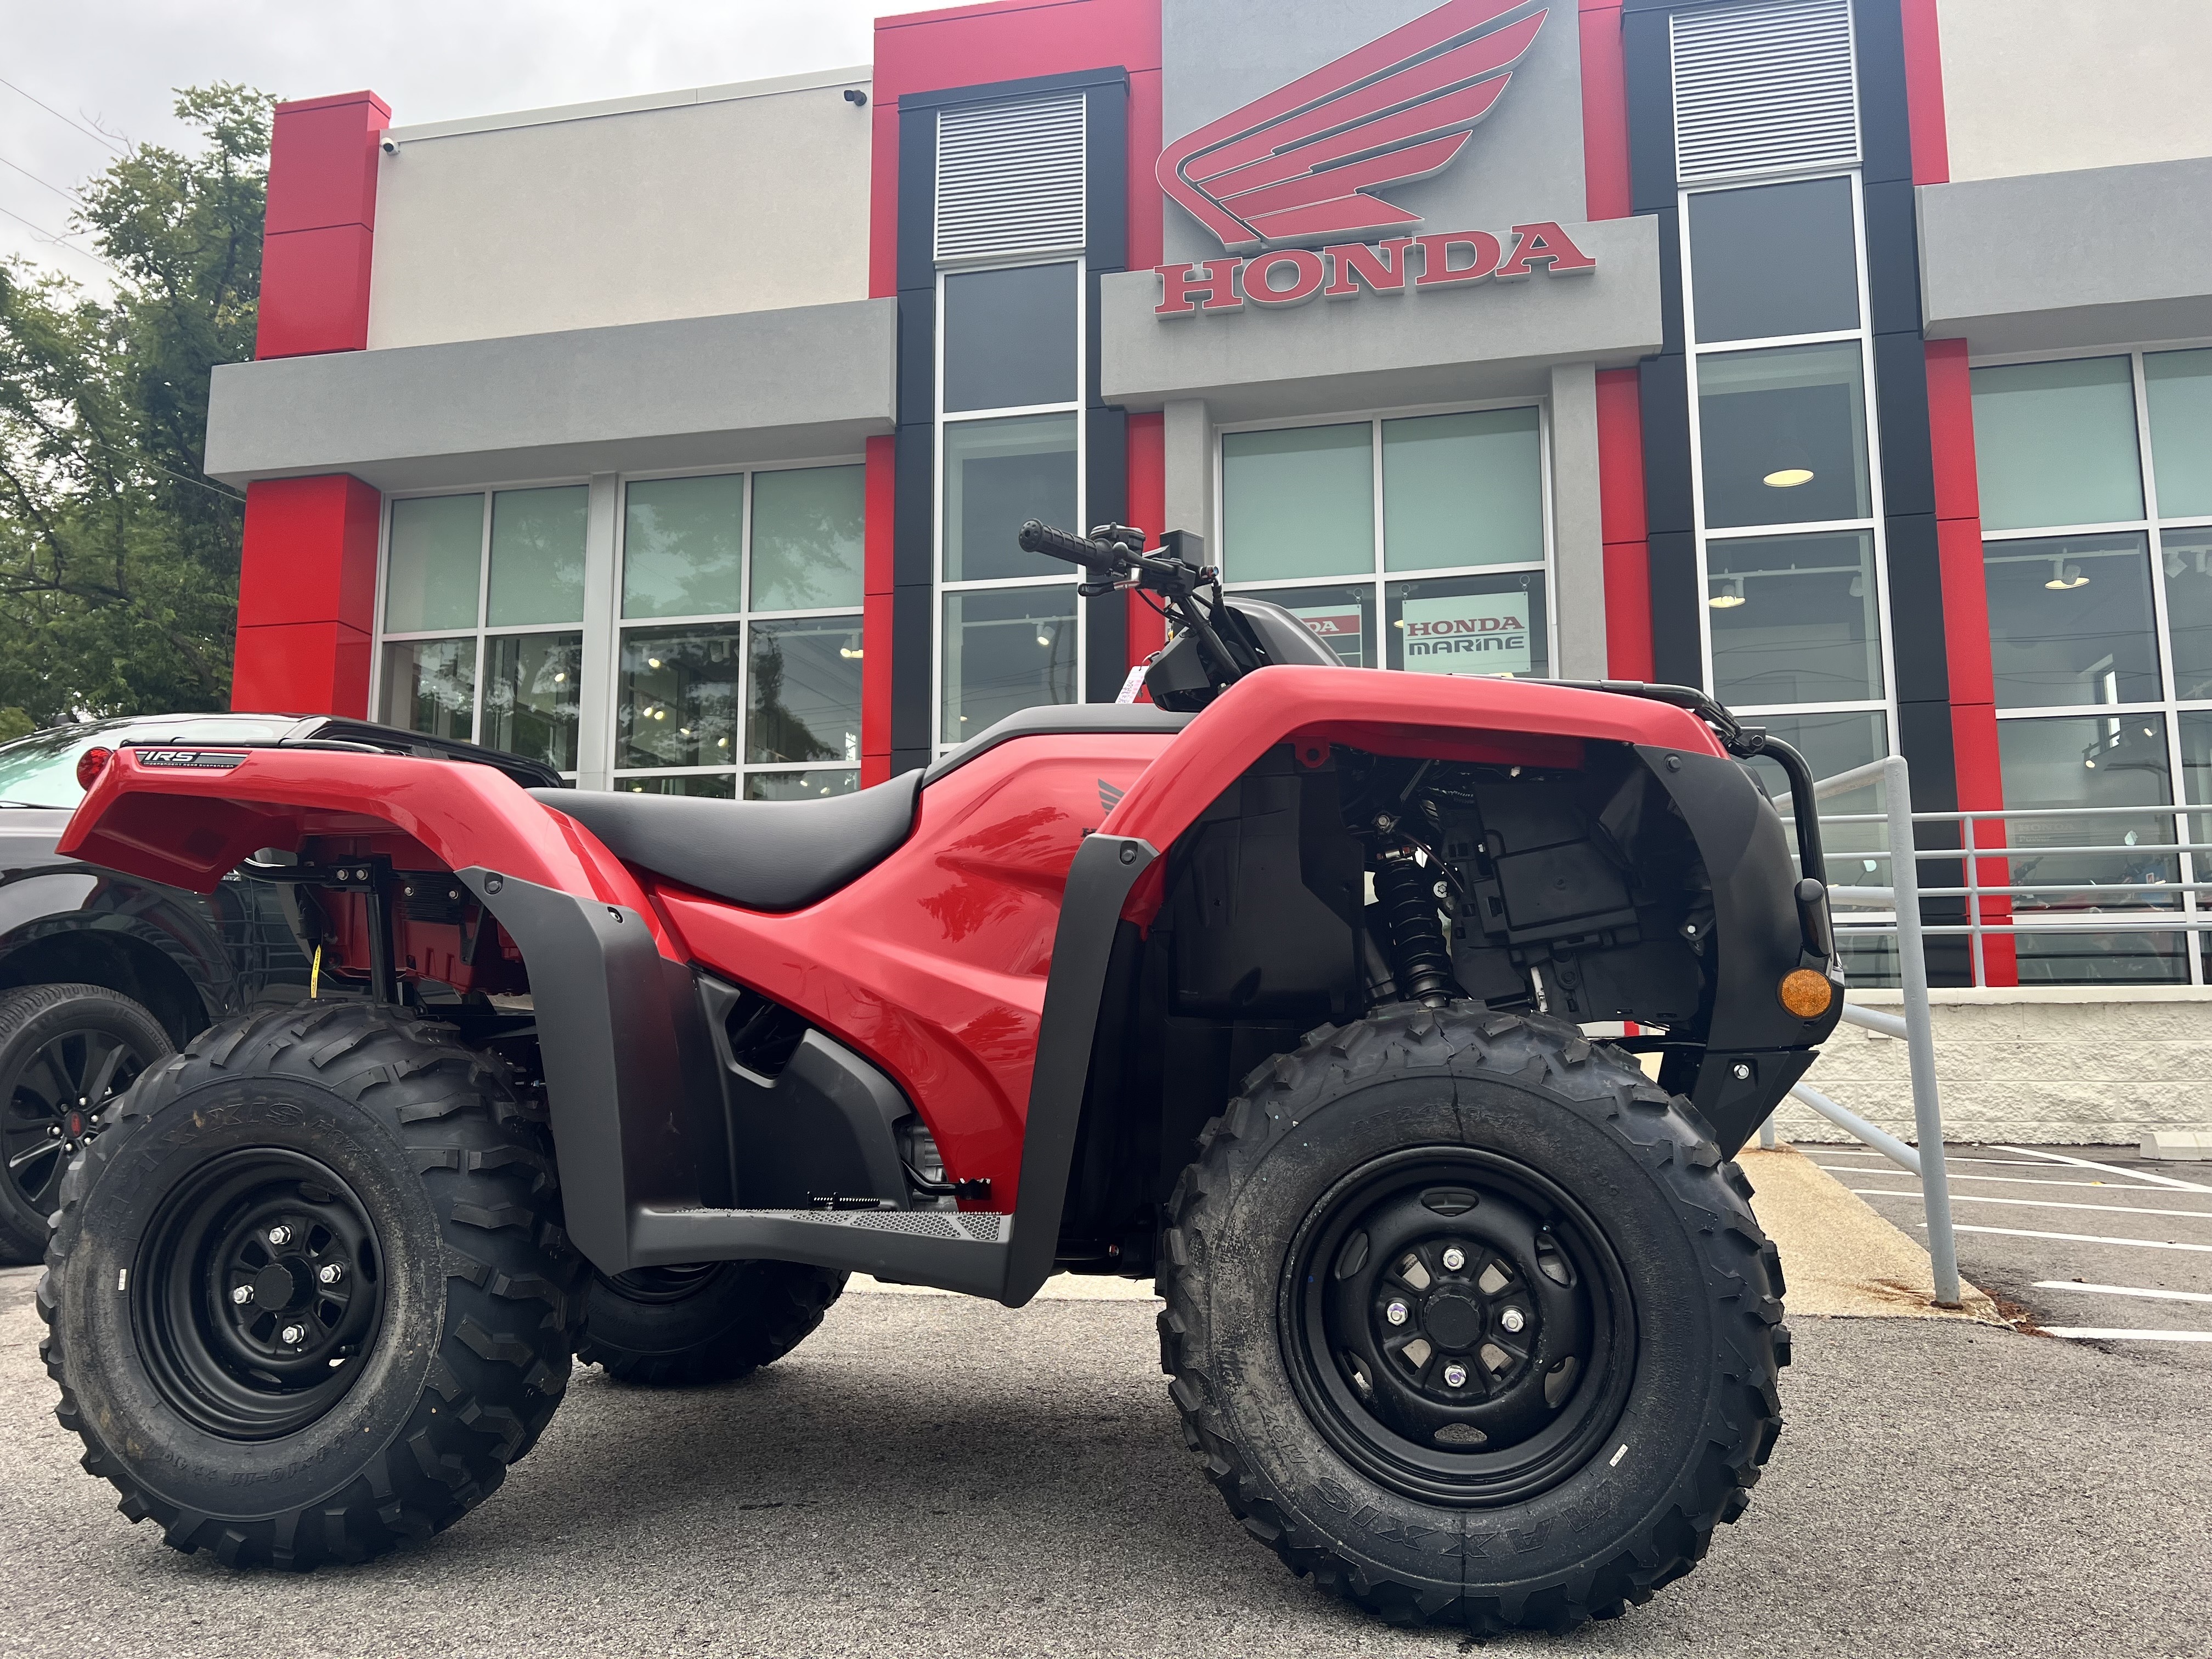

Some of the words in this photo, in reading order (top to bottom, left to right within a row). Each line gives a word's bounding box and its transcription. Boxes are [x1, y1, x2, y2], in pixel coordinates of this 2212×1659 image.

[1154, 221, 1596, 318] HONDA
[1407, 616, 1525, 636] HONDA
[1408, 636, 1525, 655] MARINE
[145, 751, 196, 761] IRS
[2018, 823, 2074, 831] HONDA
[1311, 1471, 1620, 1556] MAXXIS
